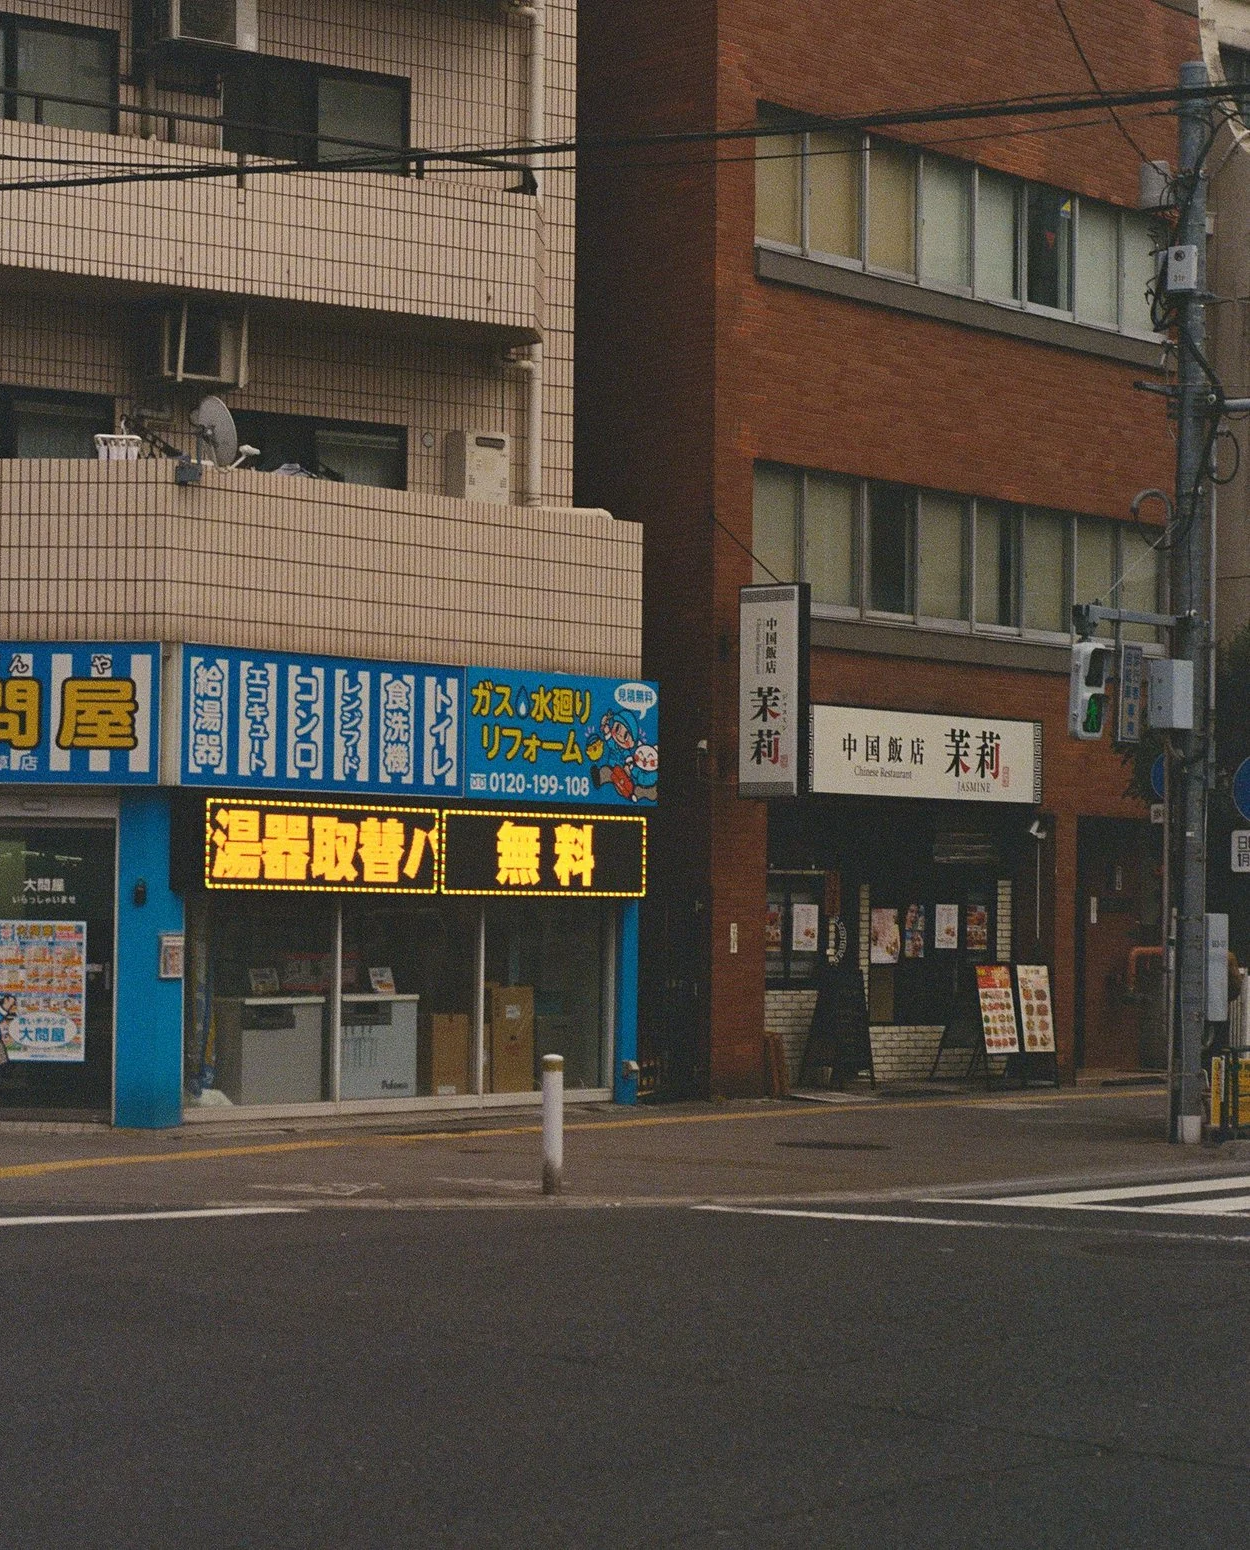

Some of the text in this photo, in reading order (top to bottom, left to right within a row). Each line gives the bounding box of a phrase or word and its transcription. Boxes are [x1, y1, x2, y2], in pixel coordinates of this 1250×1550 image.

[765, 617, 778, 675] 中国飯店
[194, 665, 224, 766] 給湯器
[248, 668, 269, 771] エコキュート
[471, 680, 592, 724] ガス 水廻り
[618, 687, 653, 704] 見積無料
[294, 675, 319, 769] コンロ
[341, 674, 362, 776] レンジフード
[384, 678, 411, 776] 食洗機
[431, 682, 453, 778] トイレ
[481, 724, 584, 766] リフォーム
[749, 686, 782, 766] 茉莉
[842, 732, 925, 766] 中国飯店
[854, 764, 913, 780] Chinese Restaurant
[944, 727, 1002, 781] 茉莉
[489, 772, 590, 797] 0120-199-108
[957, 780, 991, 794] JASMINE
[496, 820, 596, 888] 無料
[11, 894, 77, 905] いらっしゃいませ
[23, 878, 65, 893] 大問屋
[18, 1026, 66, 1043] 大問屋
